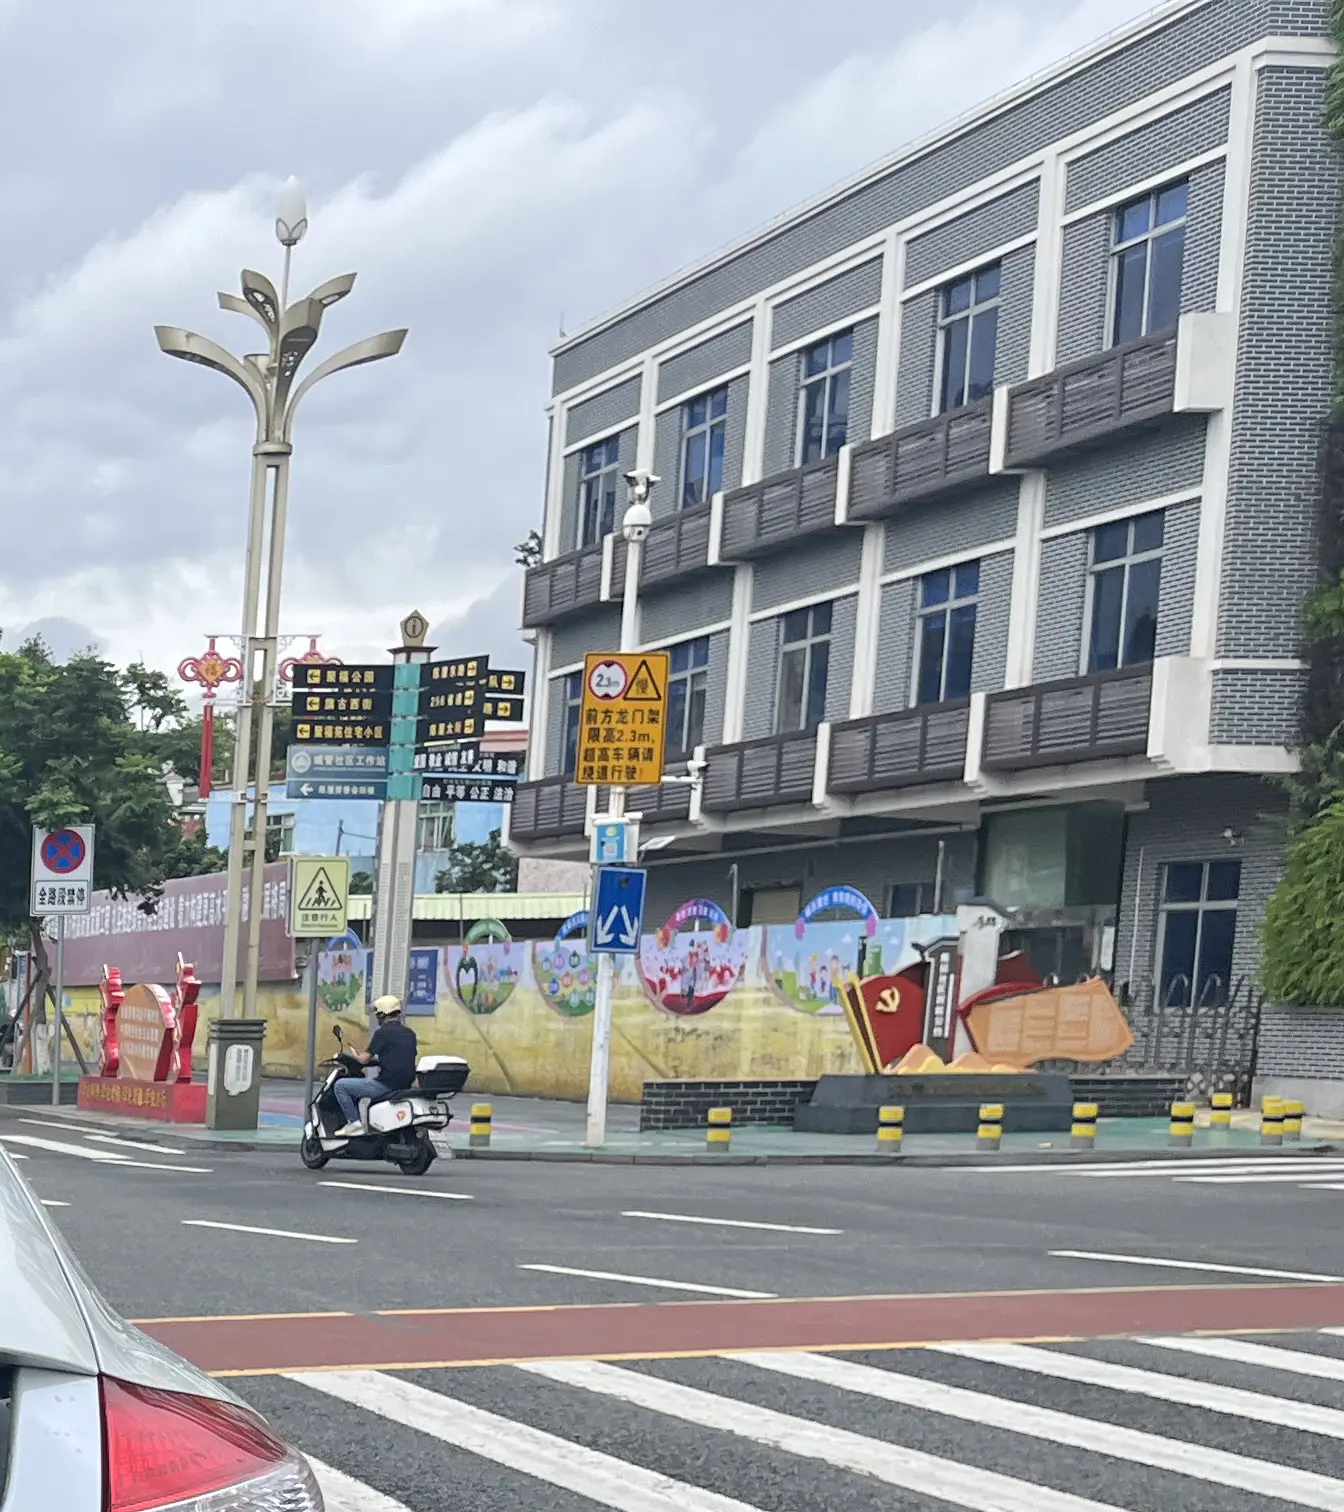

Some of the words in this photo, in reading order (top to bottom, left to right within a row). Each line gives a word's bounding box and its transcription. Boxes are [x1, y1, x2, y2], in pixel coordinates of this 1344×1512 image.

[585, 708, 660, 725] 前方龙门架
[583, 747, 654, 762] 超高车辆请
[423, 783, 441, 798] 自由
[445, 784, 466, 799] 平等
[469, 786, 490, 800] 公正
[38, 887, 85, 906] 全路段禁停
